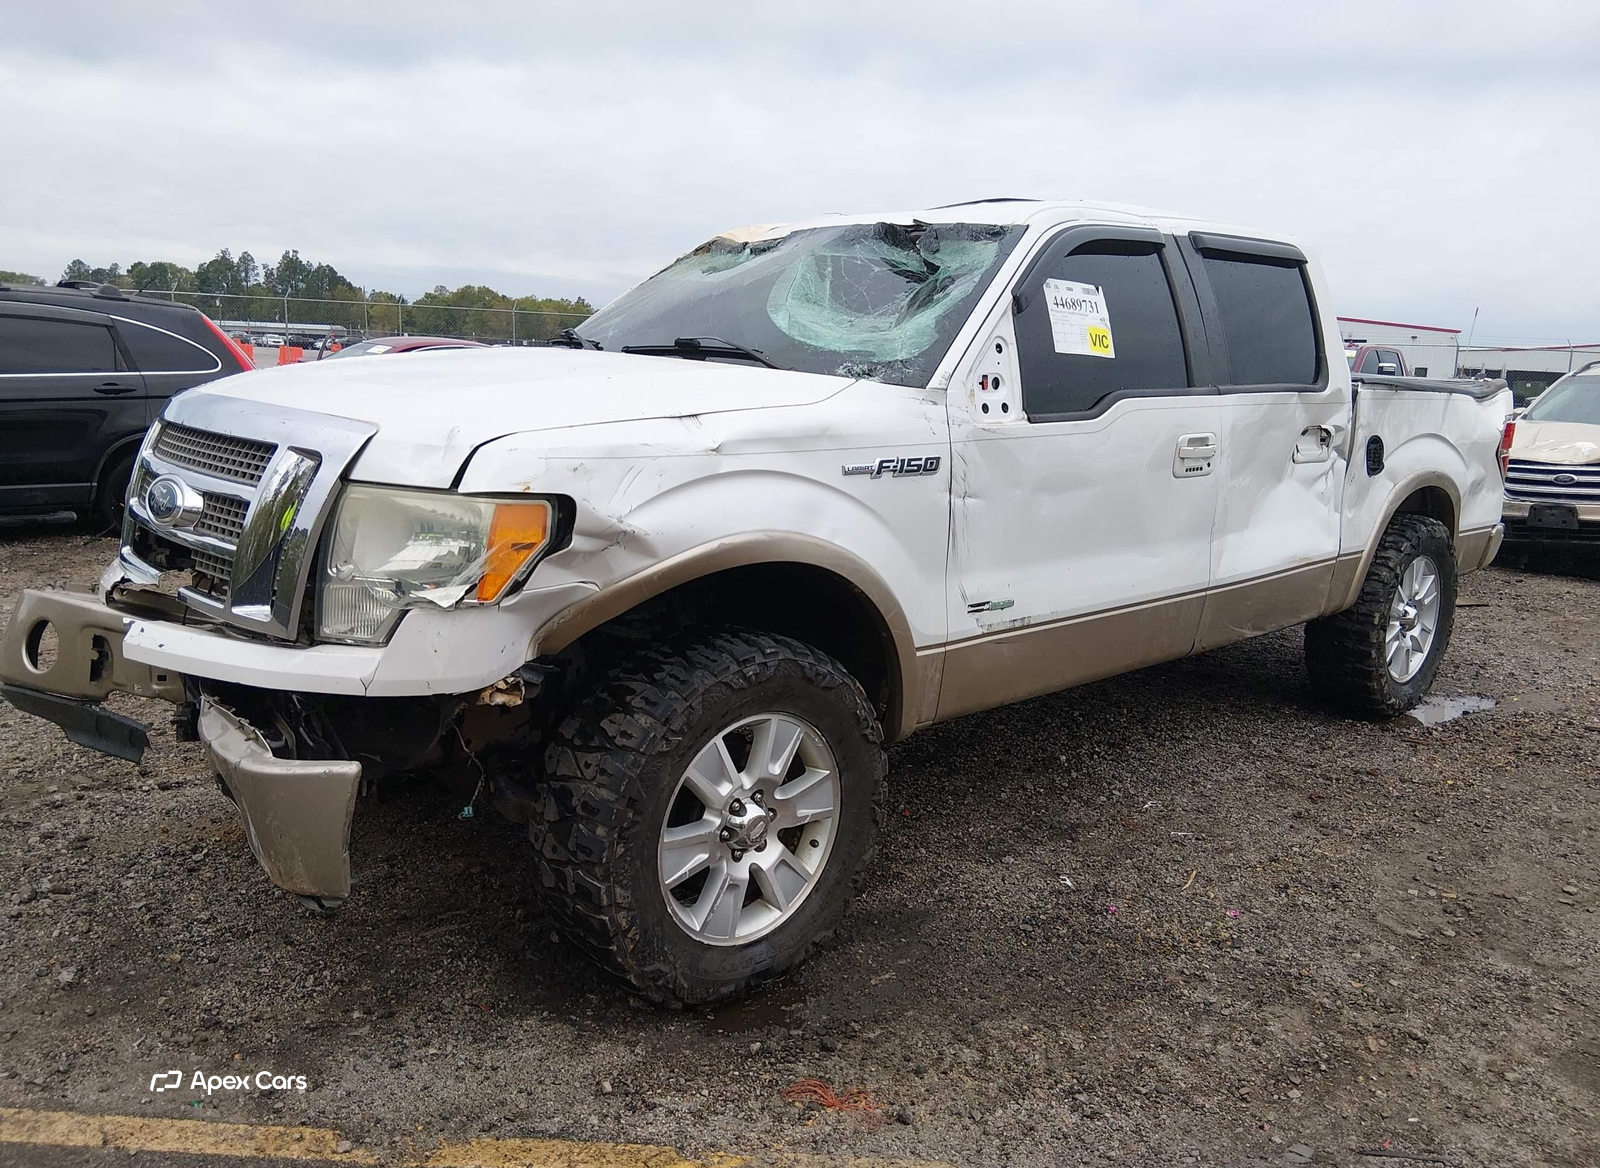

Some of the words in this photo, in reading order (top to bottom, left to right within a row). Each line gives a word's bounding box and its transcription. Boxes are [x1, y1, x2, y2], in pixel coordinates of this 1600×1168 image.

[1053, 295, 1100, 314] 44689731
[1089, 332, 1109, 349] VIC
[875, 456, 941, 475] F-150
[150, 485, 171, 511] Ford
